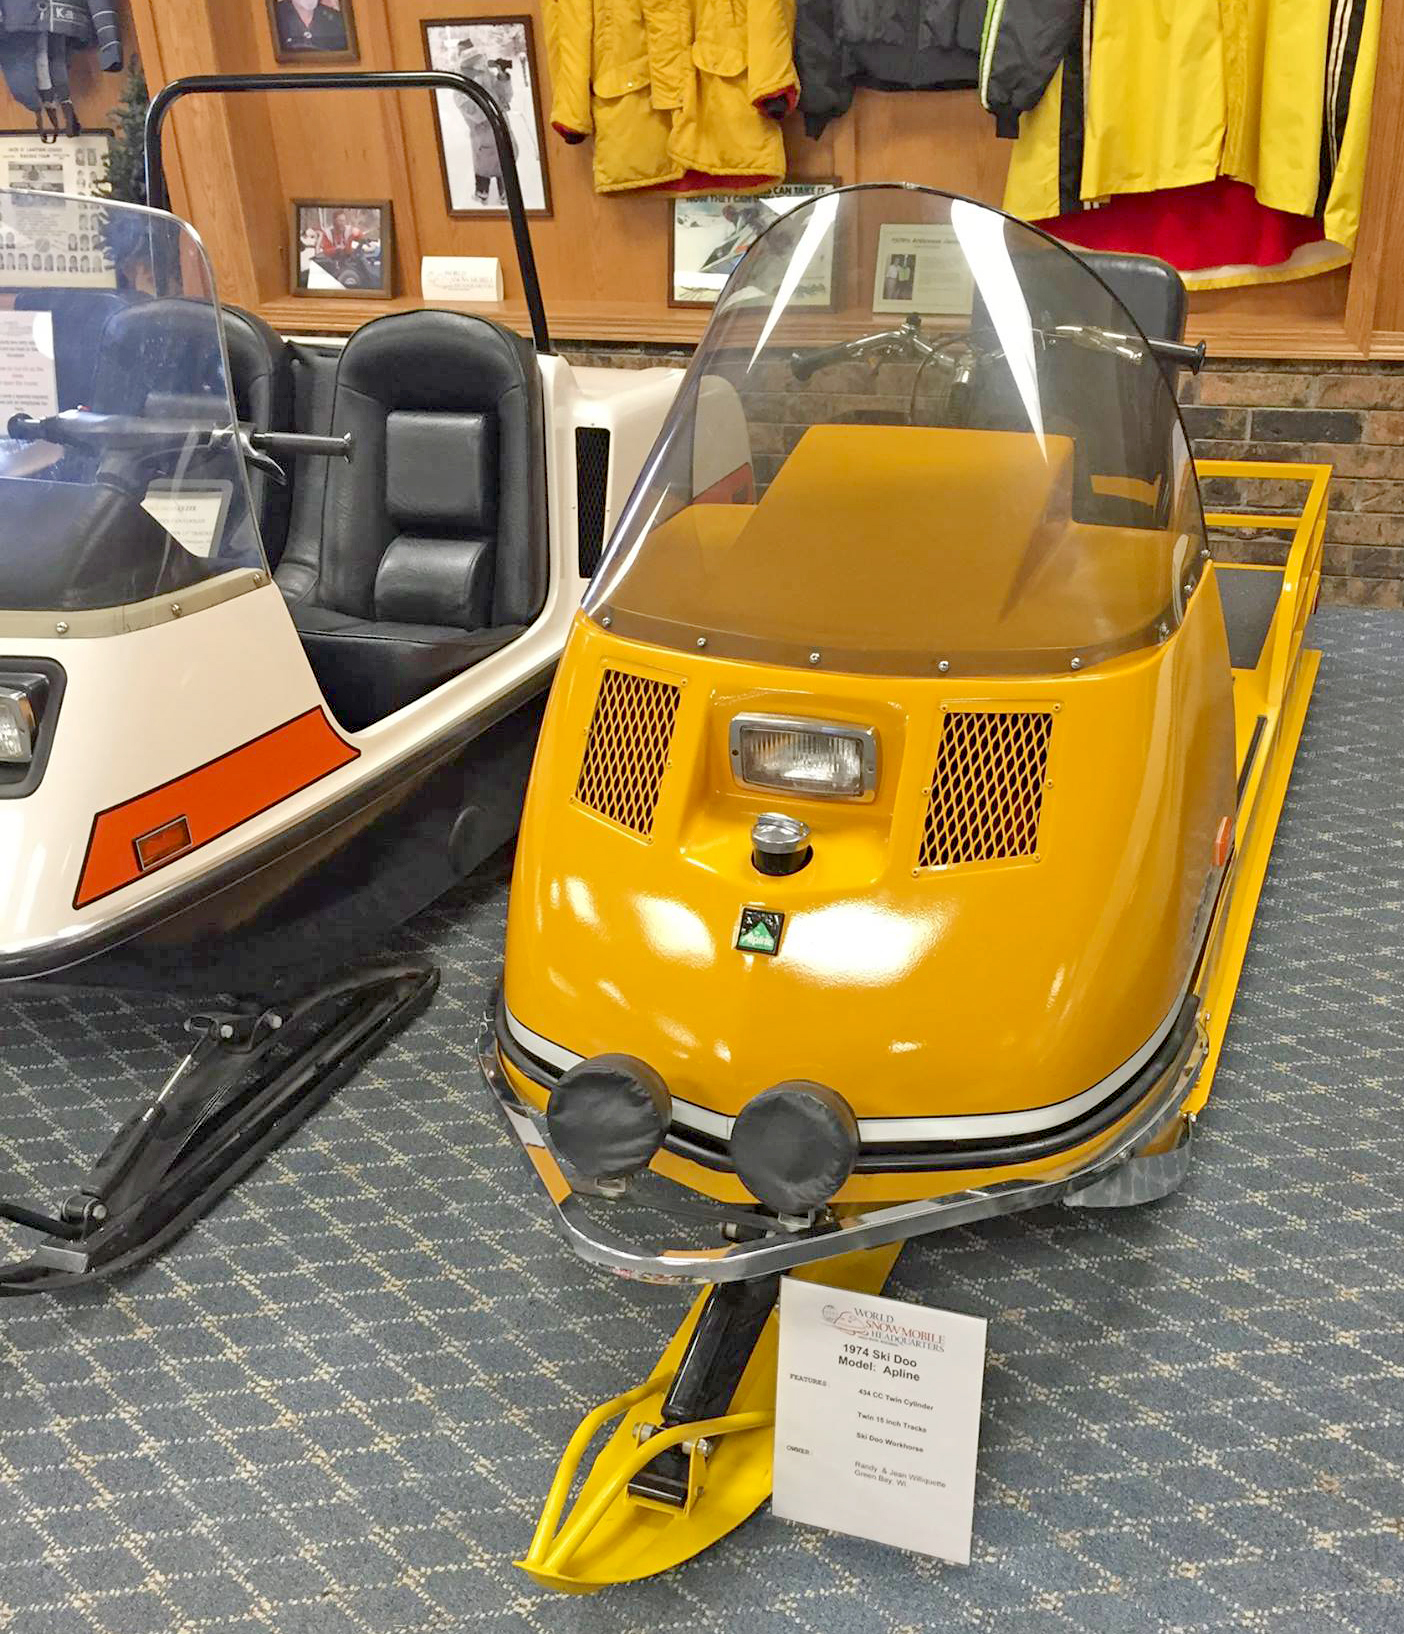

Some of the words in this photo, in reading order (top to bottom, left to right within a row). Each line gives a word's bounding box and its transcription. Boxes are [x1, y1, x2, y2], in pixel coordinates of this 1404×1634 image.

[710, 195, 732, 203] THEY
[773, 186, 792, 194] CAN
[794, 186, 815, 194] TAKE
[854, 1307, 894, 1323] WORLD
[866, 1320, 945, 1344] SNOWMOBILE
[871, 1331, 944, 1352] HEADQUARTERS
[843, 1344, 869, 1357] 1974
[872, 1350, 890, 1362] Ski
[893, 1353, 917, 1367] Doo
[838, 1356, 876, 1372] Model:
[883, 1366, 920, 1381] Apline
[859, 1388, 870, 1397] 434
[873, 1391, 883, 1400] CC
[885, 1394, 902, 1404] Twin
[904, 1398, 934, 1411] Cylinder
[857, 1411, 874, 1421] Twin
[903, 1422, 927, 1433] Tracks
[869, 1434, 883, 1444] Doo
[885, 1439, 924, 1453] Workhorse
[854, 1469, 876, 1480] Green
[855, 1461, 877, 1472] Randy
